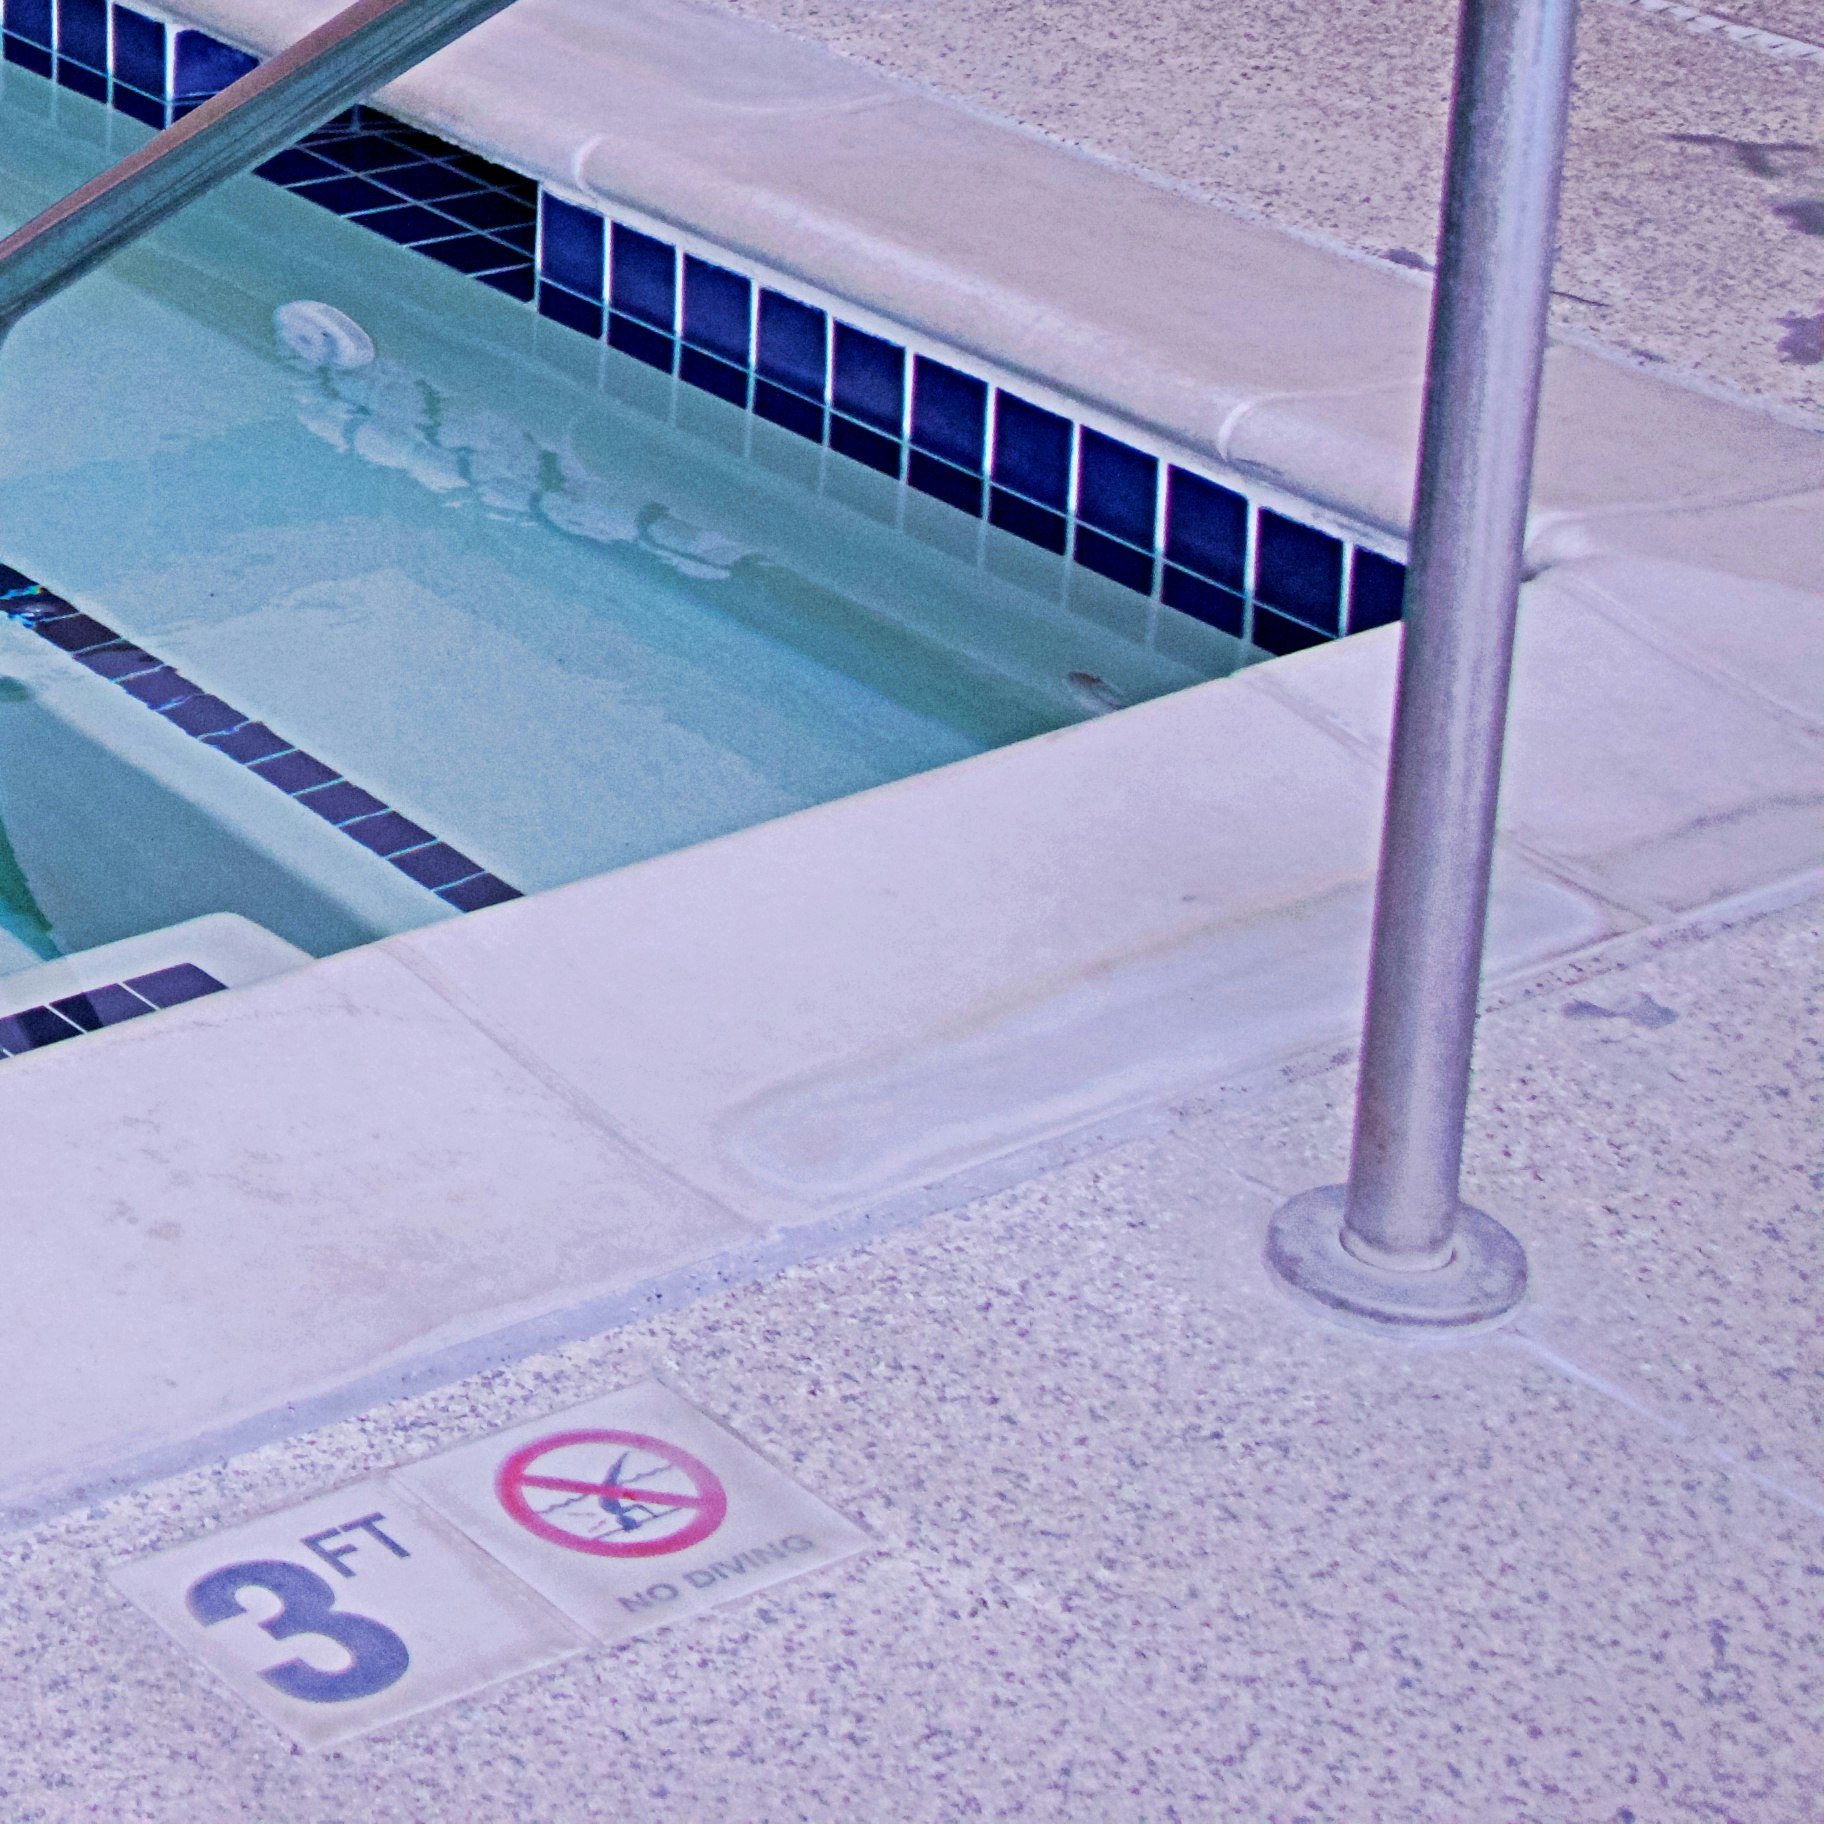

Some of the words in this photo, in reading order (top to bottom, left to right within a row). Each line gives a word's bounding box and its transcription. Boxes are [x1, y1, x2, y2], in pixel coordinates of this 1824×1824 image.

[186, 1559, 410, 1703] 3
[299, 1511, 411, 1578] FT
[617, 1583, 679, 1612] NO
[683, 1534, 813, 1589] DIVING
